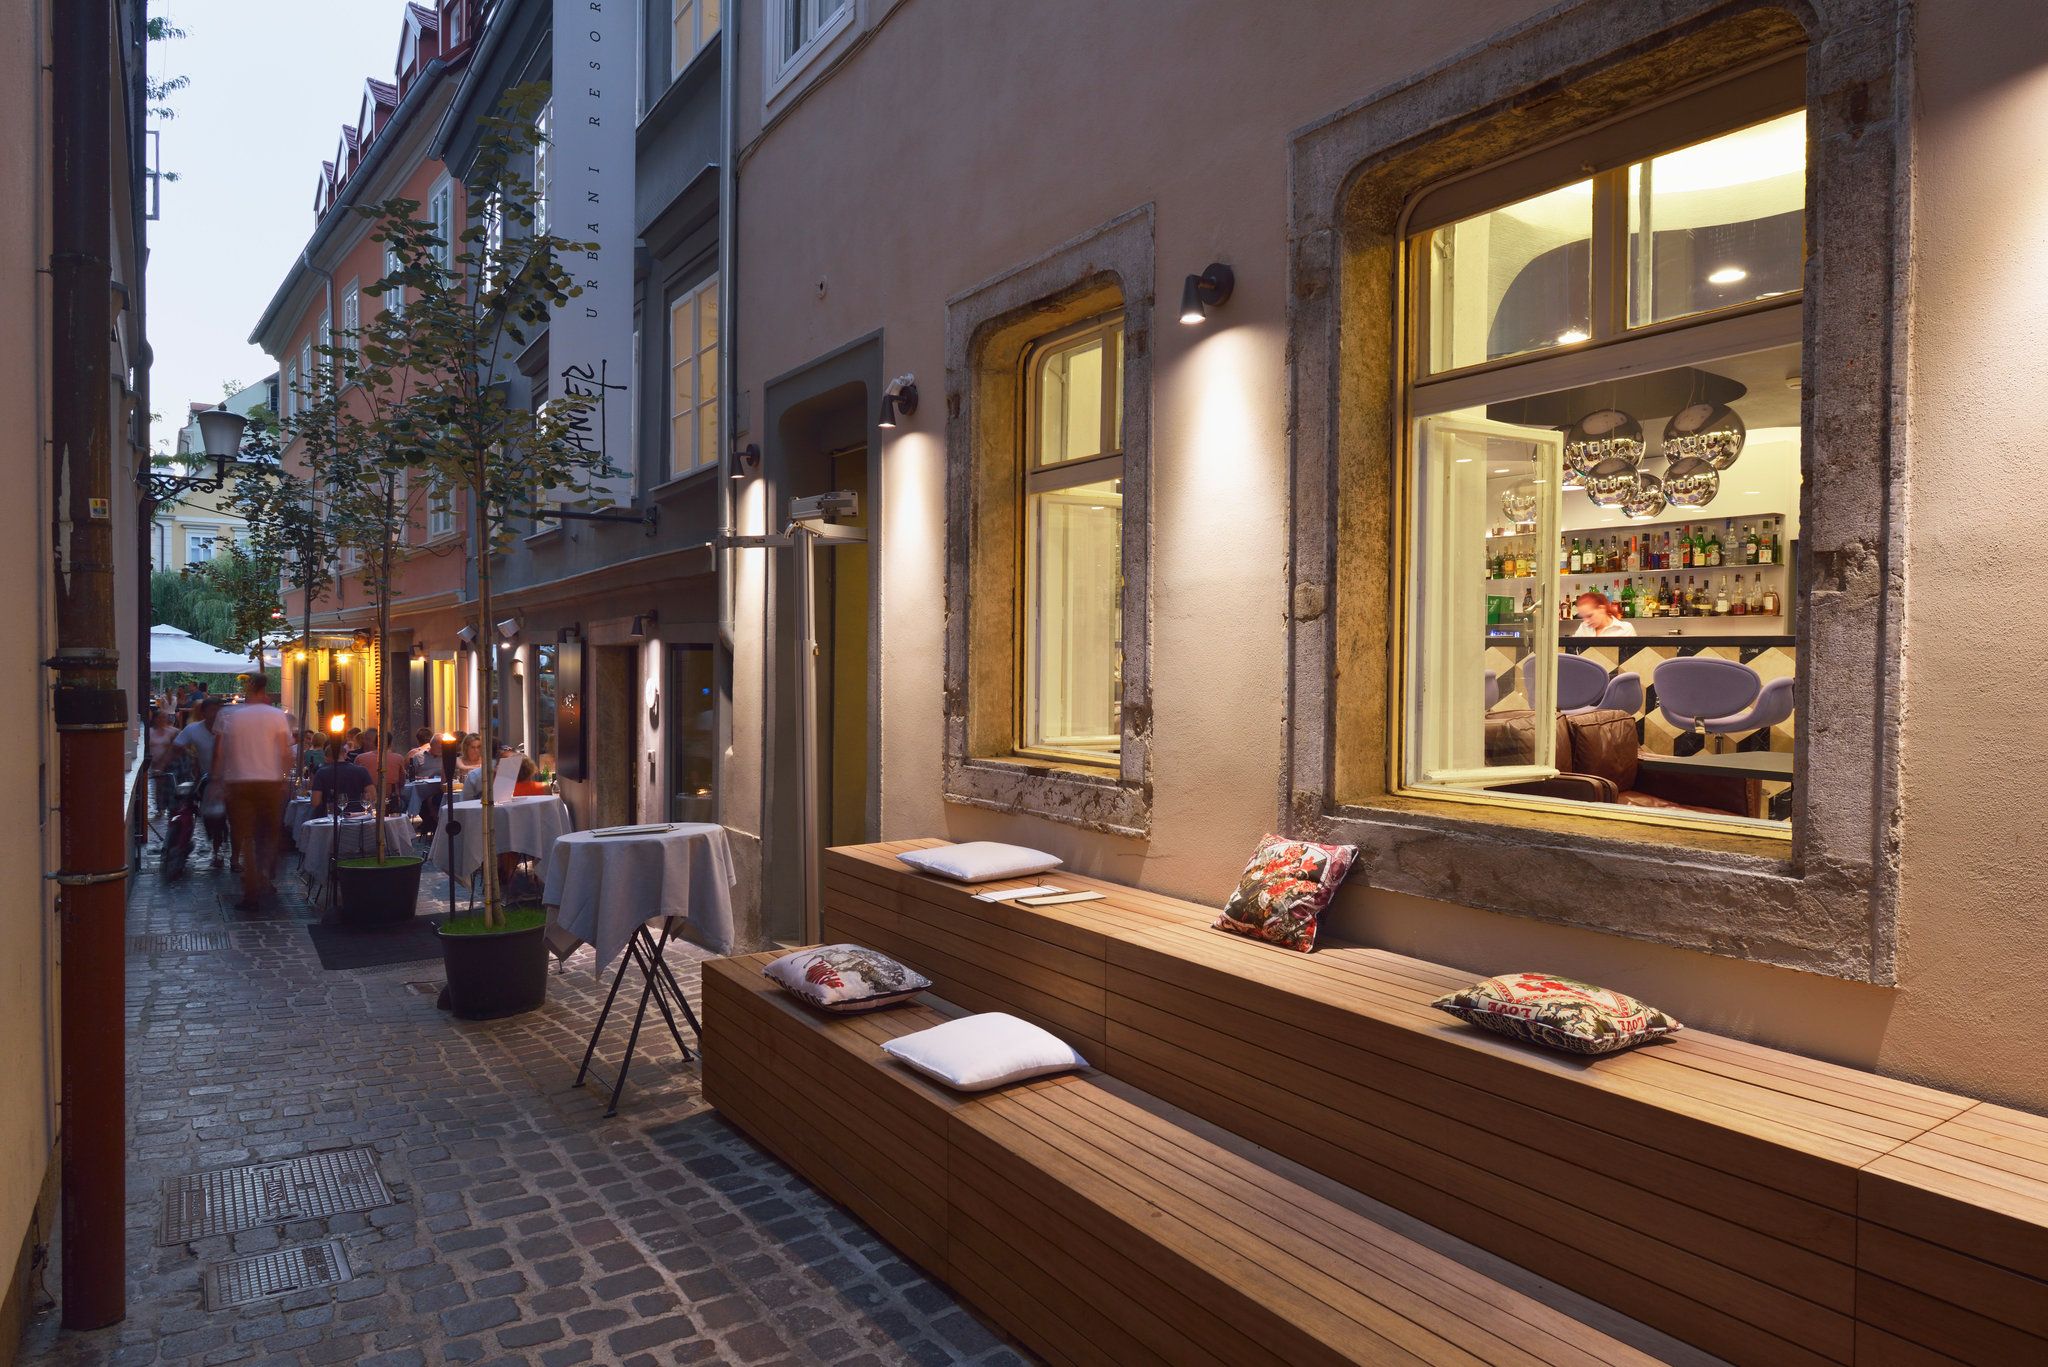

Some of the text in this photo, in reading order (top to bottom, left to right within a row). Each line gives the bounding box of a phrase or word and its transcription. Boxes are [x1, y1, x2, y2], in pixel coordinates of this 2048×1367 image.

[586, 166, 600, 319] URBANI
[1487, 1001, 1532, 1019] LOVE
[1617, 1016, 1645, 1032] LOVE
